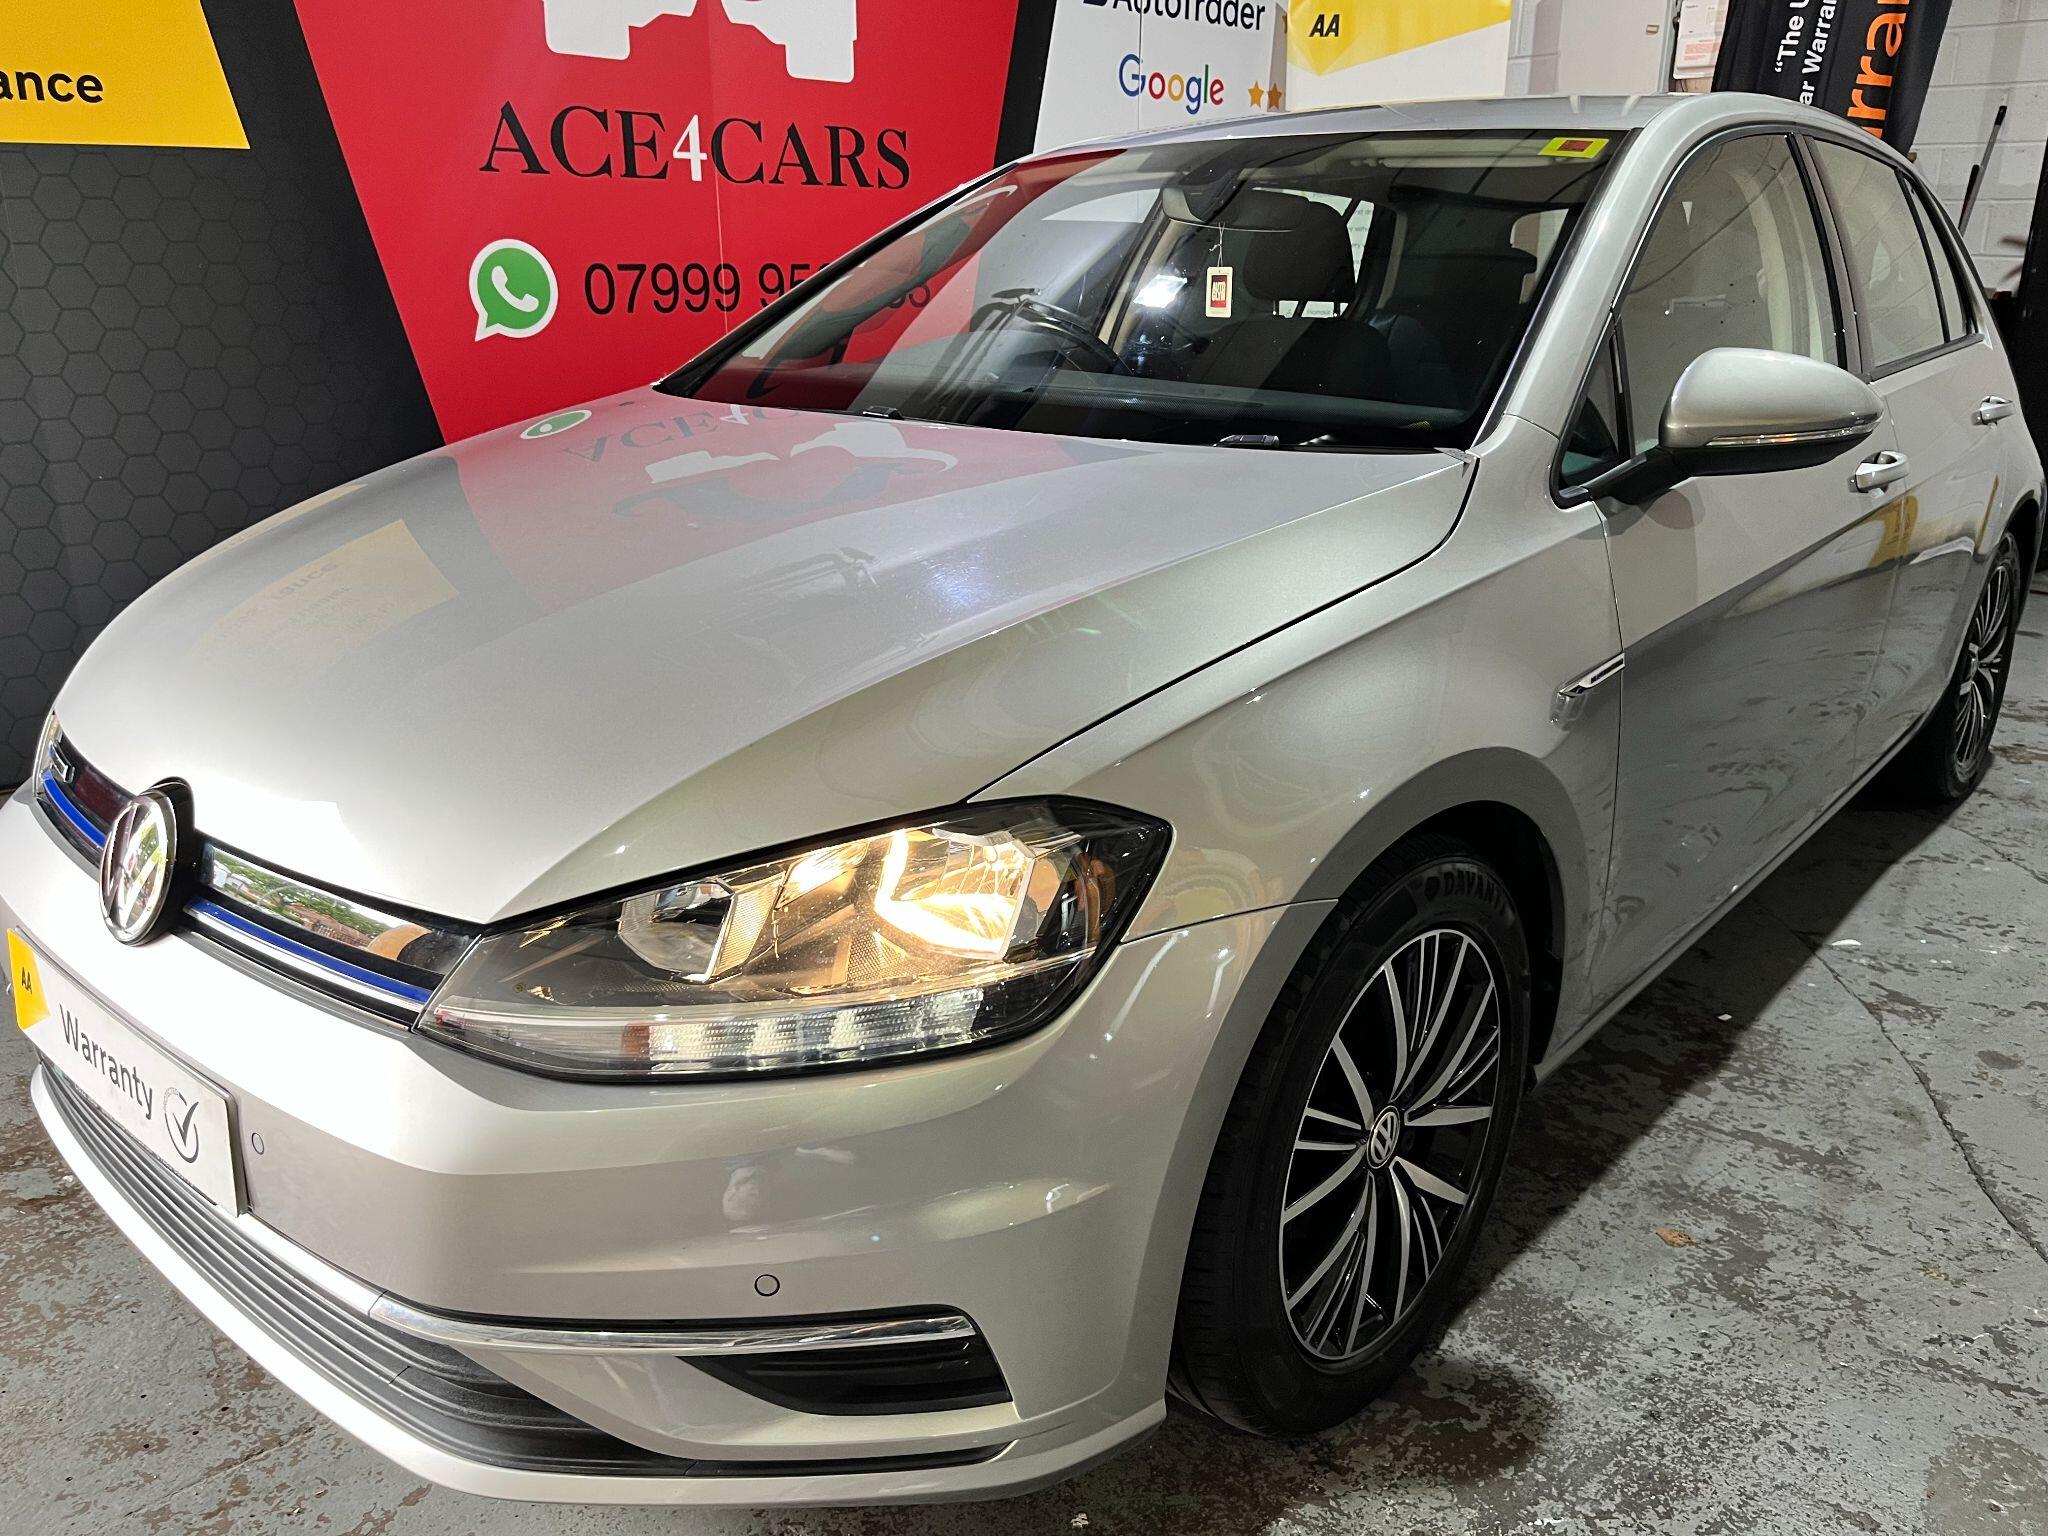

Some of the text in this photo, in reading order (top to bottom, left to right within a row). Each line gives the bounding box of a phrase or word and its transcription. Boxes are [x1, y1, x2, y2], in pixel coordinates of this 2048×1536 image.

[1309, 14, 1340, 38] AA
[1118, 53, 1225, 115] Google
[479, 100, 910, 190] ACE4CARS
[584, 262, 741, 315] 07999
[21, 967, 33, 994] AA
[59, 1003, 153, 1121] Warranty
